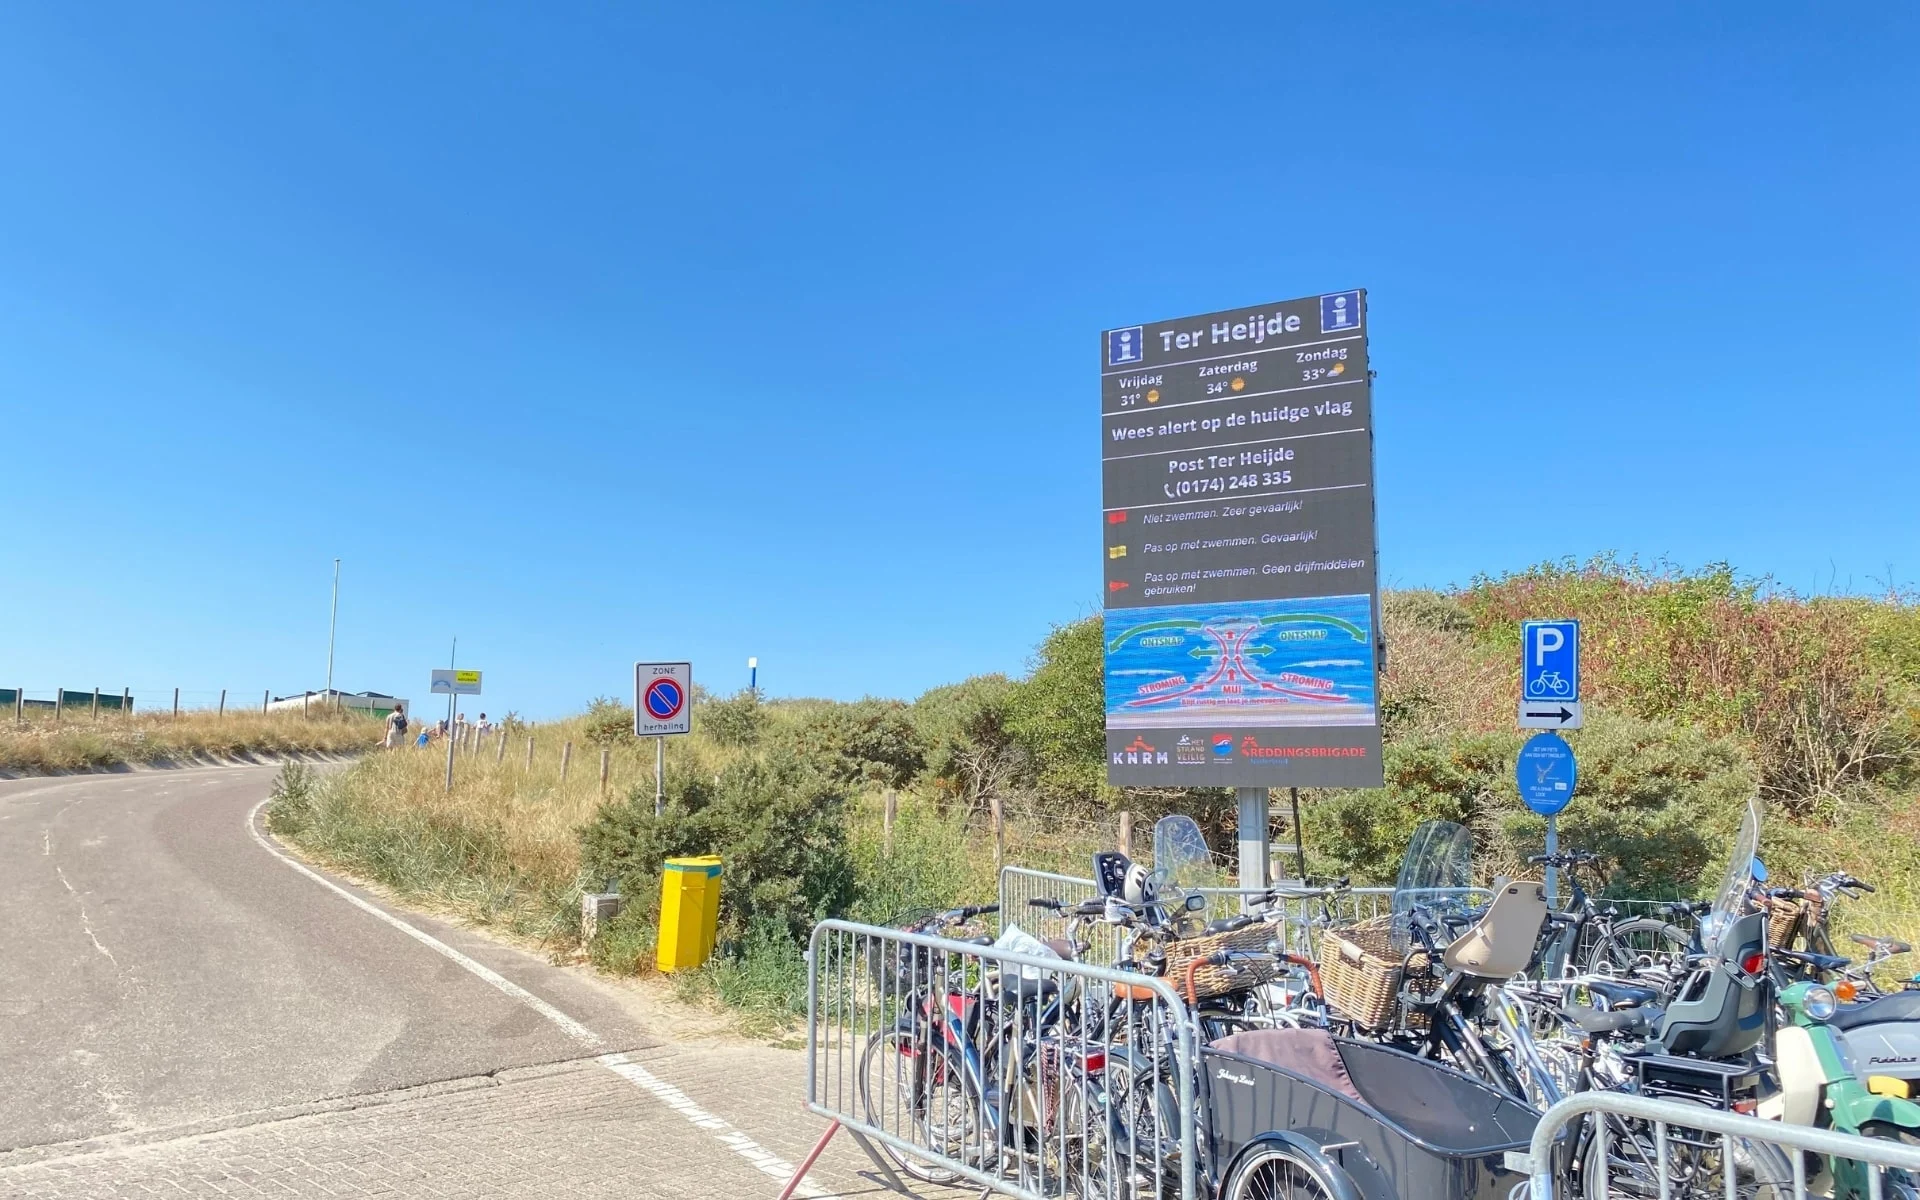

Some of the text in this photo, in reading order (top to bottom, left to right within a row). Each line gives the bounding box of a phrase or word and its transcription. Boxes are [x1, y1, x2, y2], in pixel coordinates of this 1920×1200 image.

[1159, 312, 1301, 352] Ter Heijde
[1296, 346, 1348, 364] Zondag
[1199, 359, 1258, 377] Zaterdag
[1302, 367, 1326, 382] 33°
[1119, 373, 1163, 390] Vrijdag
[1206, 380, 1228, 395] 34°
[1120, 392, 1142, 407] 31°
[1112, 401, 1353, 441] Wees alert op de huidge vlag
[1169, 448, 1295, 474] Post Ter Heijde
[1176, 470, 1292, 497] (0174) 248 335
[1143, 500, 1304, 524] Niet zwemmen. Zeer gevaarlijk!
[1144, 529, 1319, 554] Pas op met zwemmen. Gevaarlijk!
[1144, 558, 1365, 583] Pas op met zwemmen. Geen drijfmiddelen
[1144, 583, 1196, 597] gebruiken!
[1141, 636, 1184, 647] ONTSNAP
[1280, 630, 1327, 641] ONTSNAP
[1536, 627, 1565, 667] P
[652, 667, 676, 675] ZONE
[1139, 676, 1185, 694] STROMING
[1223, 685, 1241, 694] MUI
[1281, 673, 1332, 690] STROMING
[644, 723, 684, 731] herhaling
[1113, 751, 1168, 764] KNRM
[1250, 747, 1366, 757] REDDINGSBRIGADE
